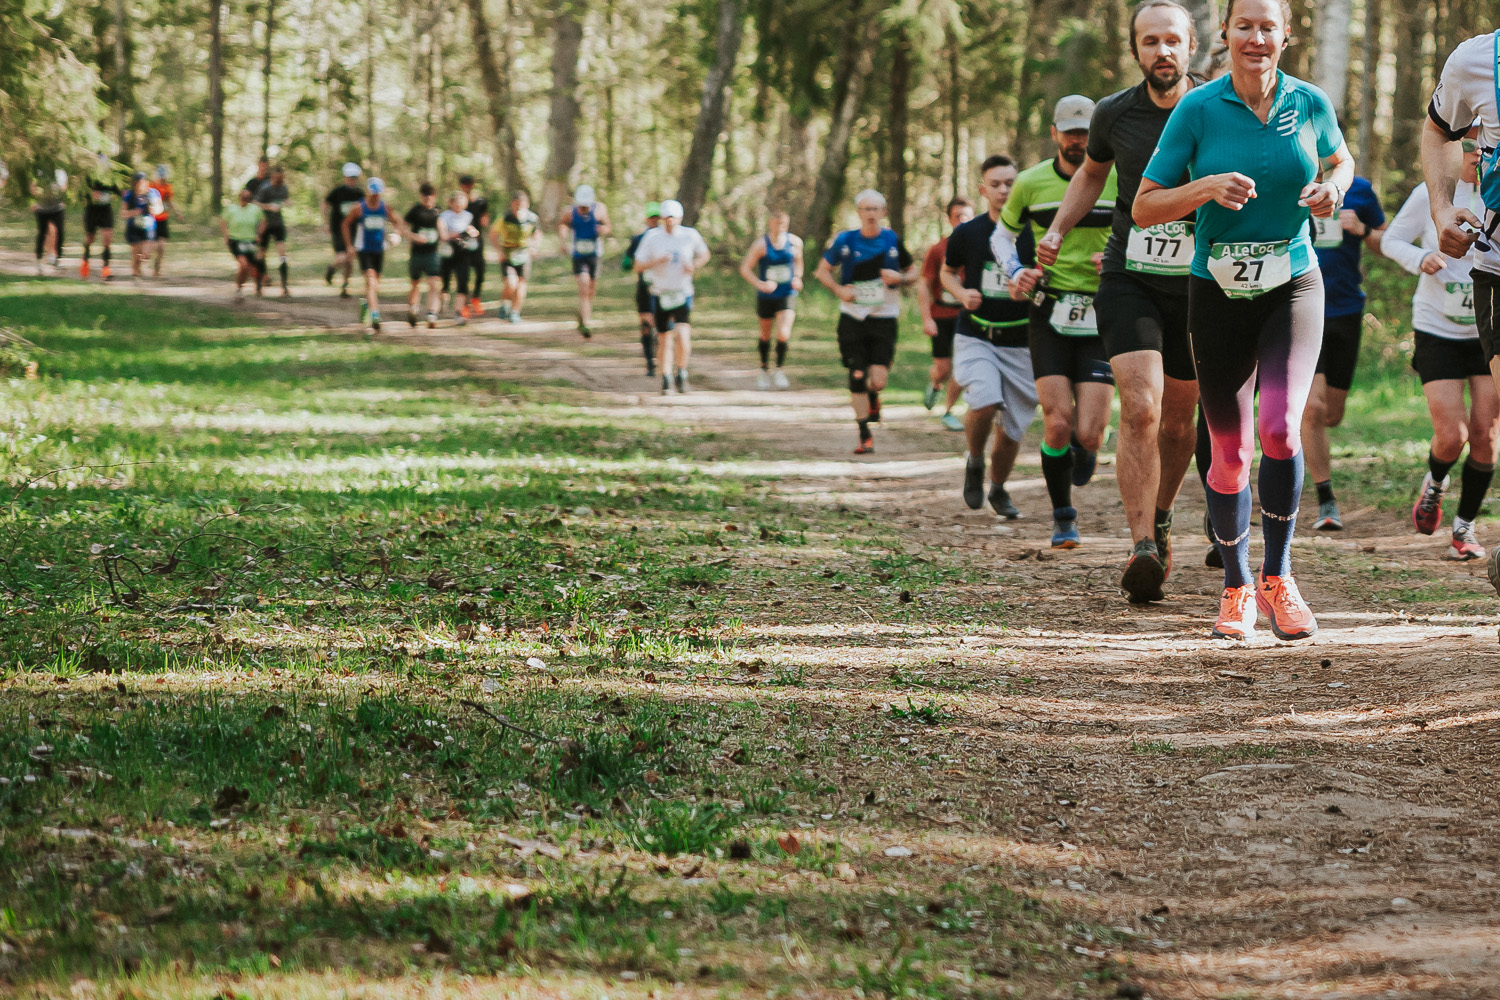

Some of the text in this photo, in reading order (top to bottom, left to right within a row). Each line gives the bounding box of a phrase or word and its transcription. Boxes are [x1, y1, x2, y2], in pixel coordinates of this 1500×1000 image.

[1144, 237, 1182, 257] 177
[1221, 244, 1275, 257] A.LeCoq
[1232, 260, 1264, 282] 27
[1069, 307, 1087, 322] 61
